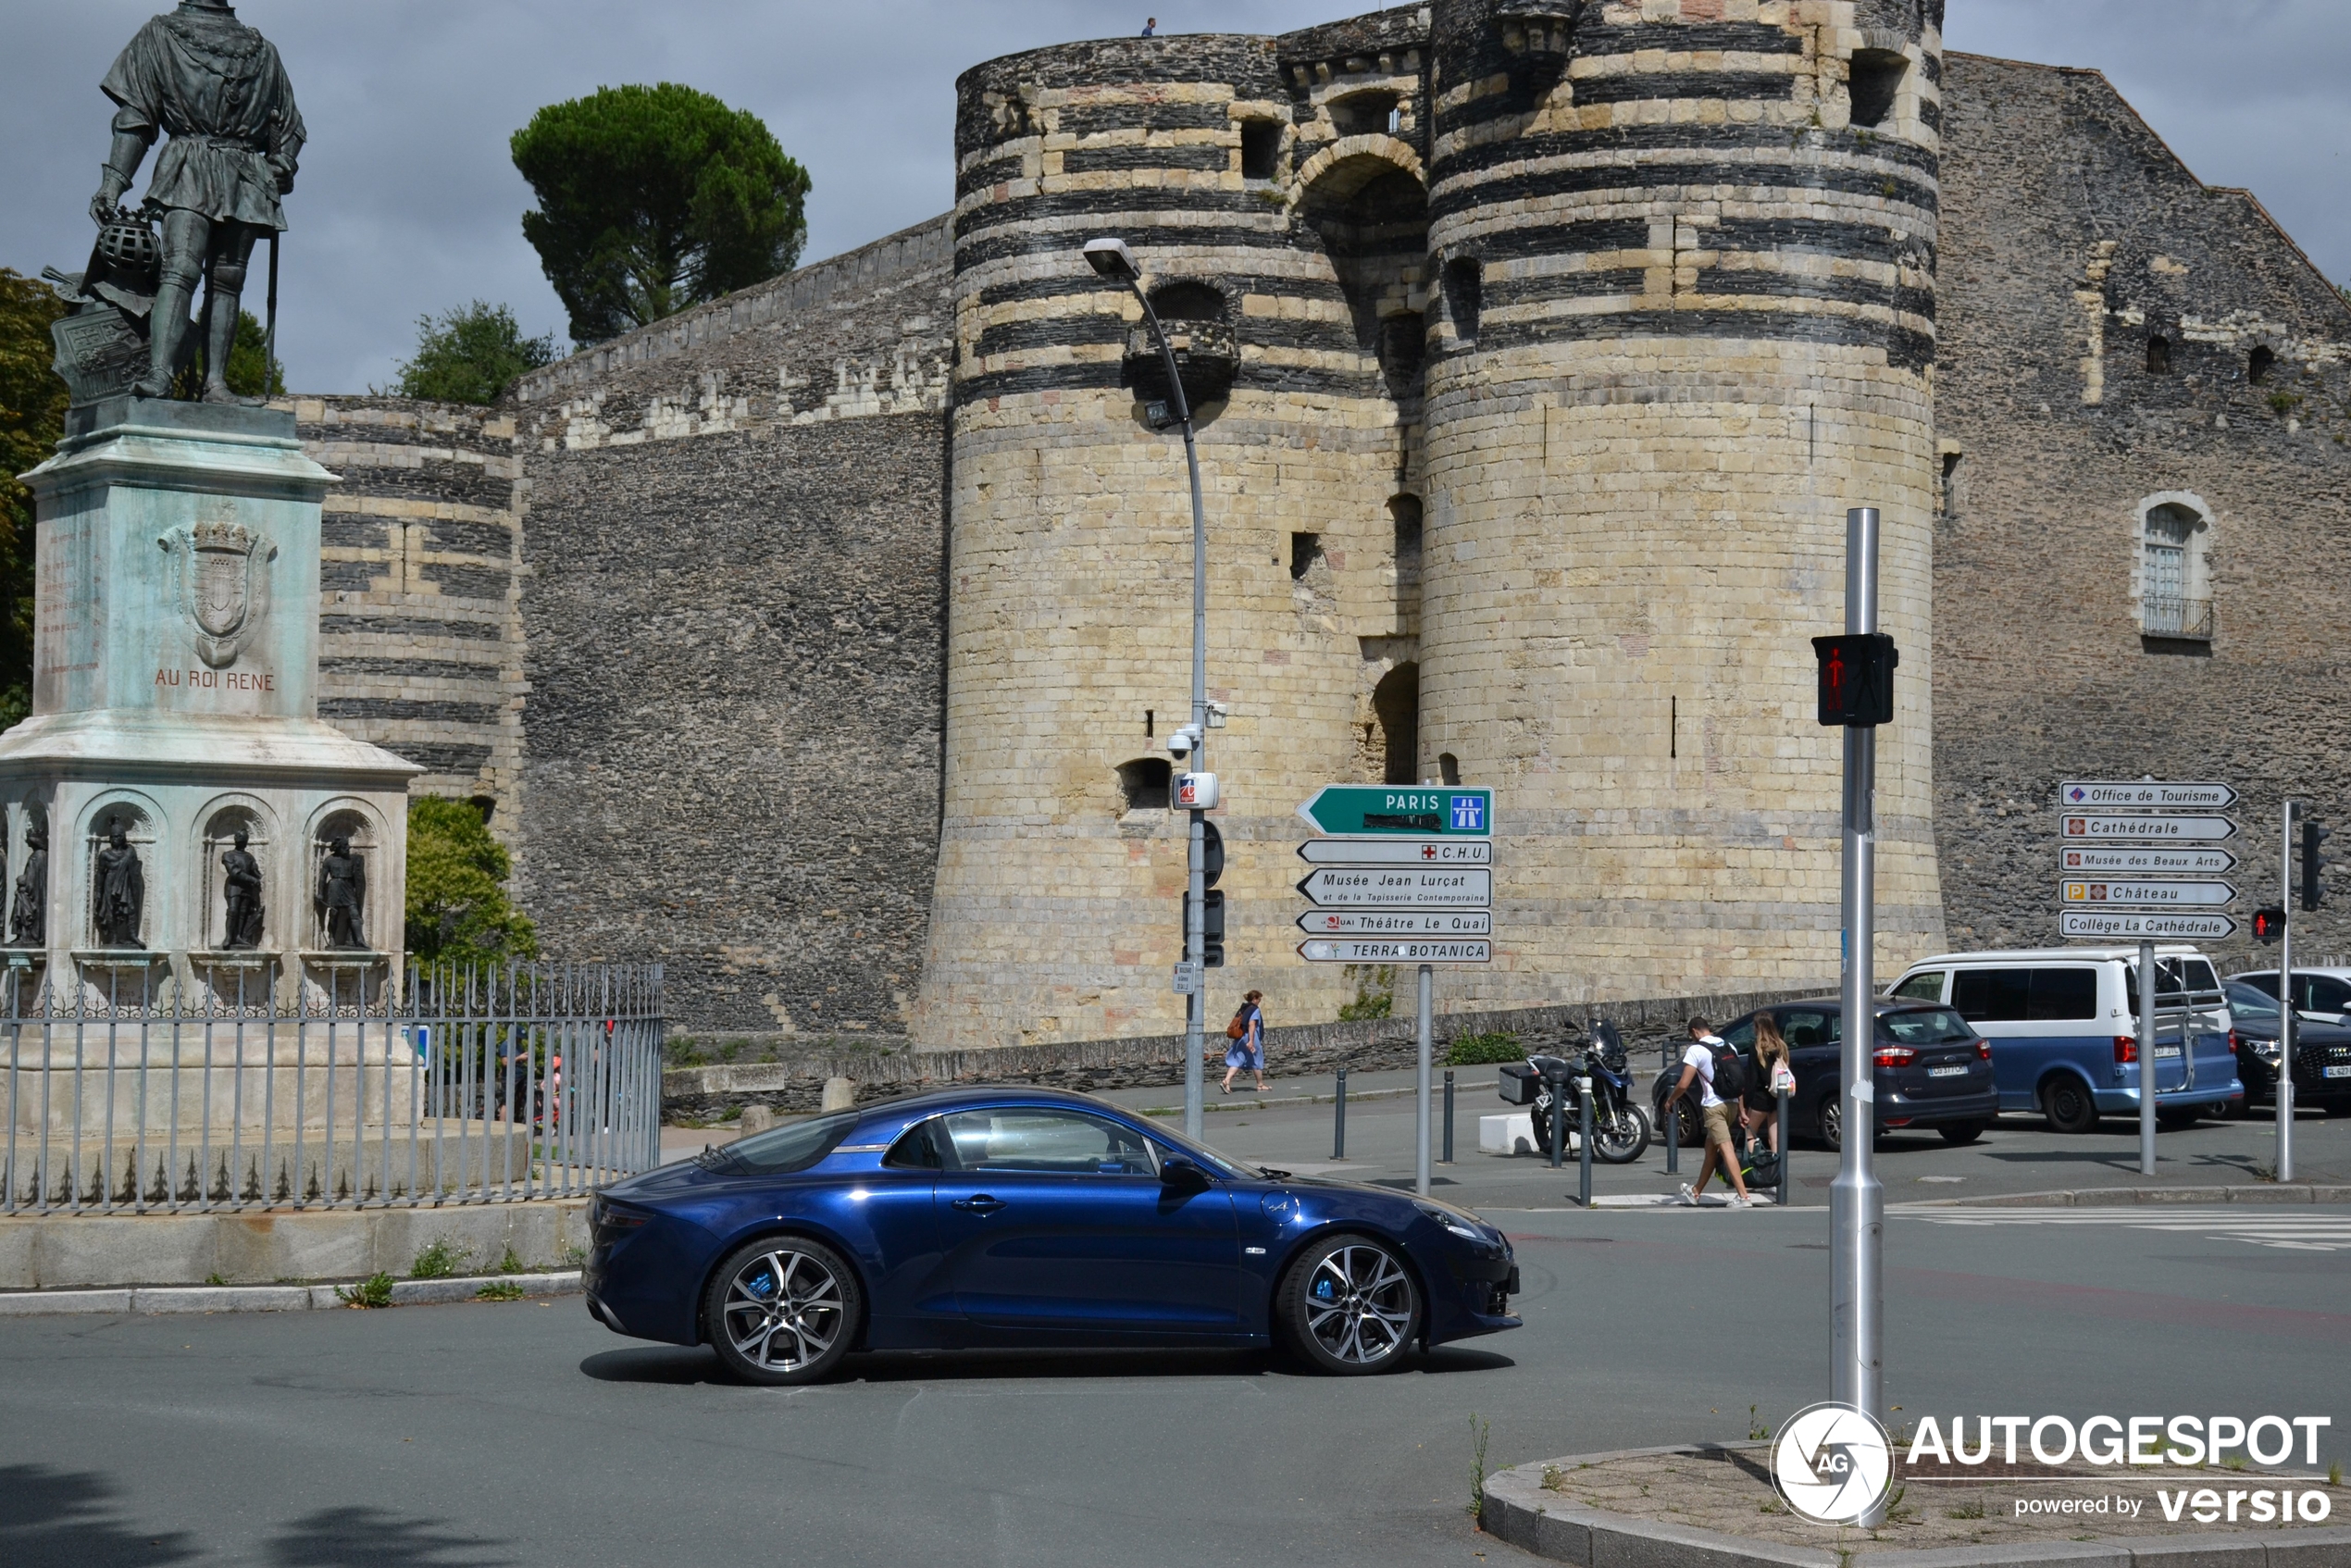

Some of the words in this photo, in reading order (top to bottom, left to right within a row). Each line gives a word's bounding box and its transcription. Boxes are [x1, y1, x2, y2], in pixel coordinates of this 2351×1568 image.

[155, 668, 180, 686] AU
[189, 671, 218, 688] ROI
[227, 673, 275, 691] RENE
[2092, 790, 2132, 801] Office
[2138, 790, 2152, 801] de
[2160, 790, 2219, 801] Tourisme
[1387, 795, 1438, 809] PARIS
[2091, 822, 2178, 833] Cathédrale
[1442, 848, 1485, 859] C.H.U.
[2084, 855, 2121, 865] Musée
[2129, 856, 2147, 865] des
[2155, 856, 2188, 865] Beaux
[2196, 857, 2220, 865] Arts
[1324, 875, 1369, 886] Musée
[1378, 875, 1412, 886] Jean
[1421, 875, 1465, 887] Lurçat
[1368, 894, 1412, 902] Tapisserie
[1417, 894, 1485, 902] Contemporaine
[2113, 888, 2178, 899] Château
[1361, 917, 1413, 927] Théâtre
[1425, 918, 1439, 928] Le
[1452, 918, 1486, 928] Quai
[2070, 919, 2120, 933] Collège
[2125, 920, 2139, 931] La
[2146, 920, 2220, 932] Cathédrale
[1352, 945, 1399, 956] TERRA
[1410, 946, 1485, 956] BOTANICA
